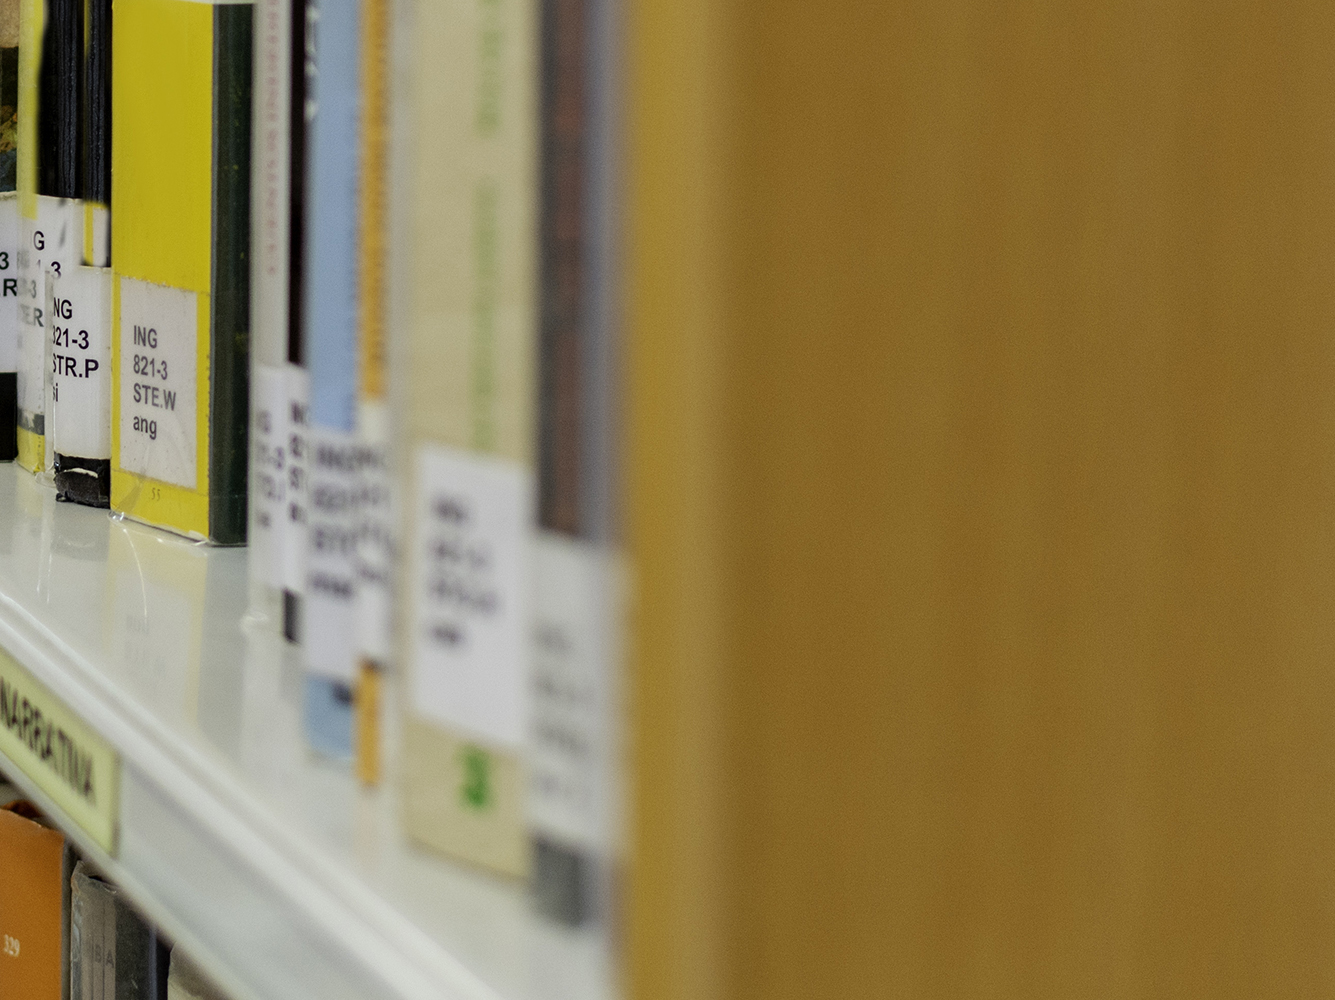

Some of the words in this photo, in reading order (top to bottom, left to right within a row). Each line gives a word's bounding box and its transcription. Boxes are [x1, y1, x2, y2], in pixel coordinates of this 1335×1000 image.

[133, 325, 158, 349] ING
[133, 354, 168, 381] 821-3
[133, 382, 177, 411] STE.W
[133, 416, 157, 440] ang
